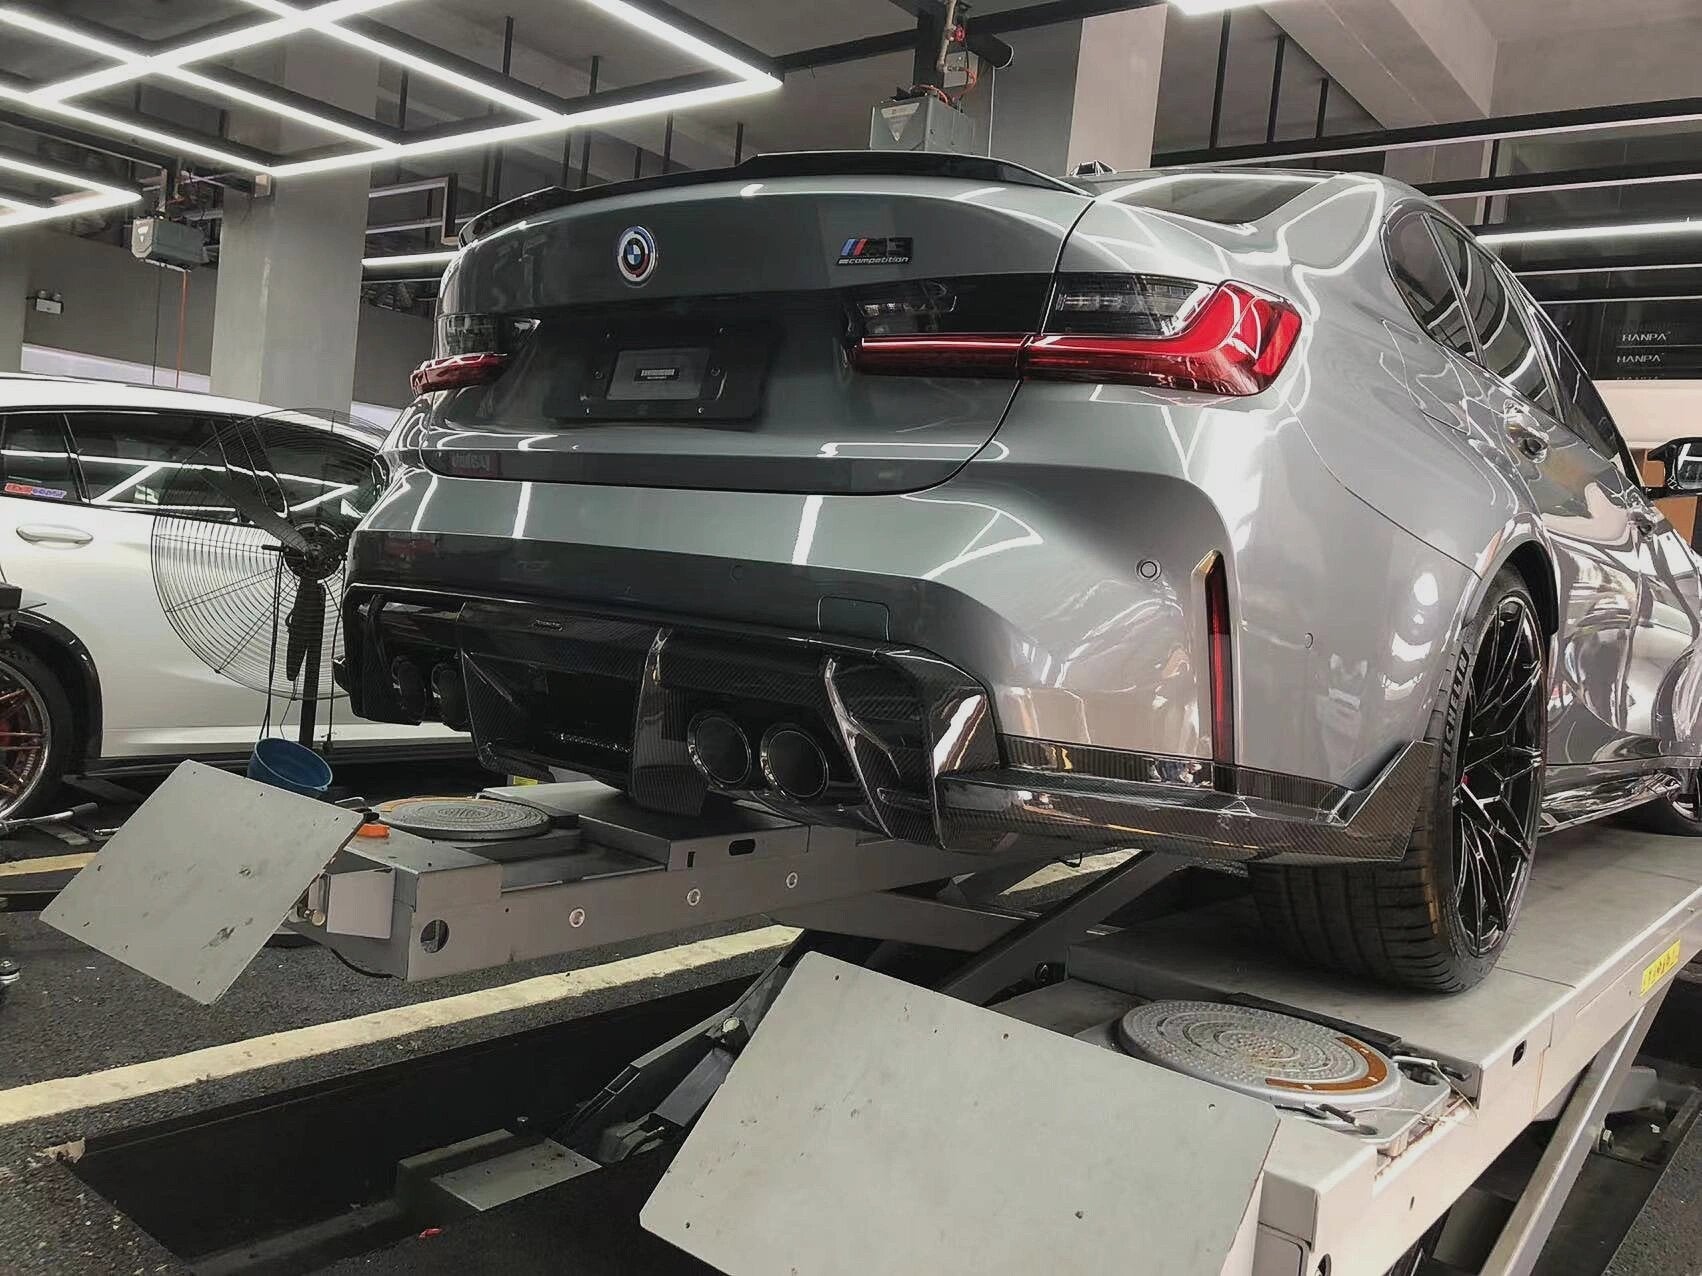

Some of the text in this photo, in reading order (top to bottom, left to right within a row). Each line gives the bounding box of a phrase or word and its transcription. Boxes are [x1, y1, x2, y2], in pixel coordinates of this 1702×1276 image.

[848, 256, 909, 264] competition
[1622, 333, 1667, 341] HANPA
[1616, 354, 1661, 363] HANPA
